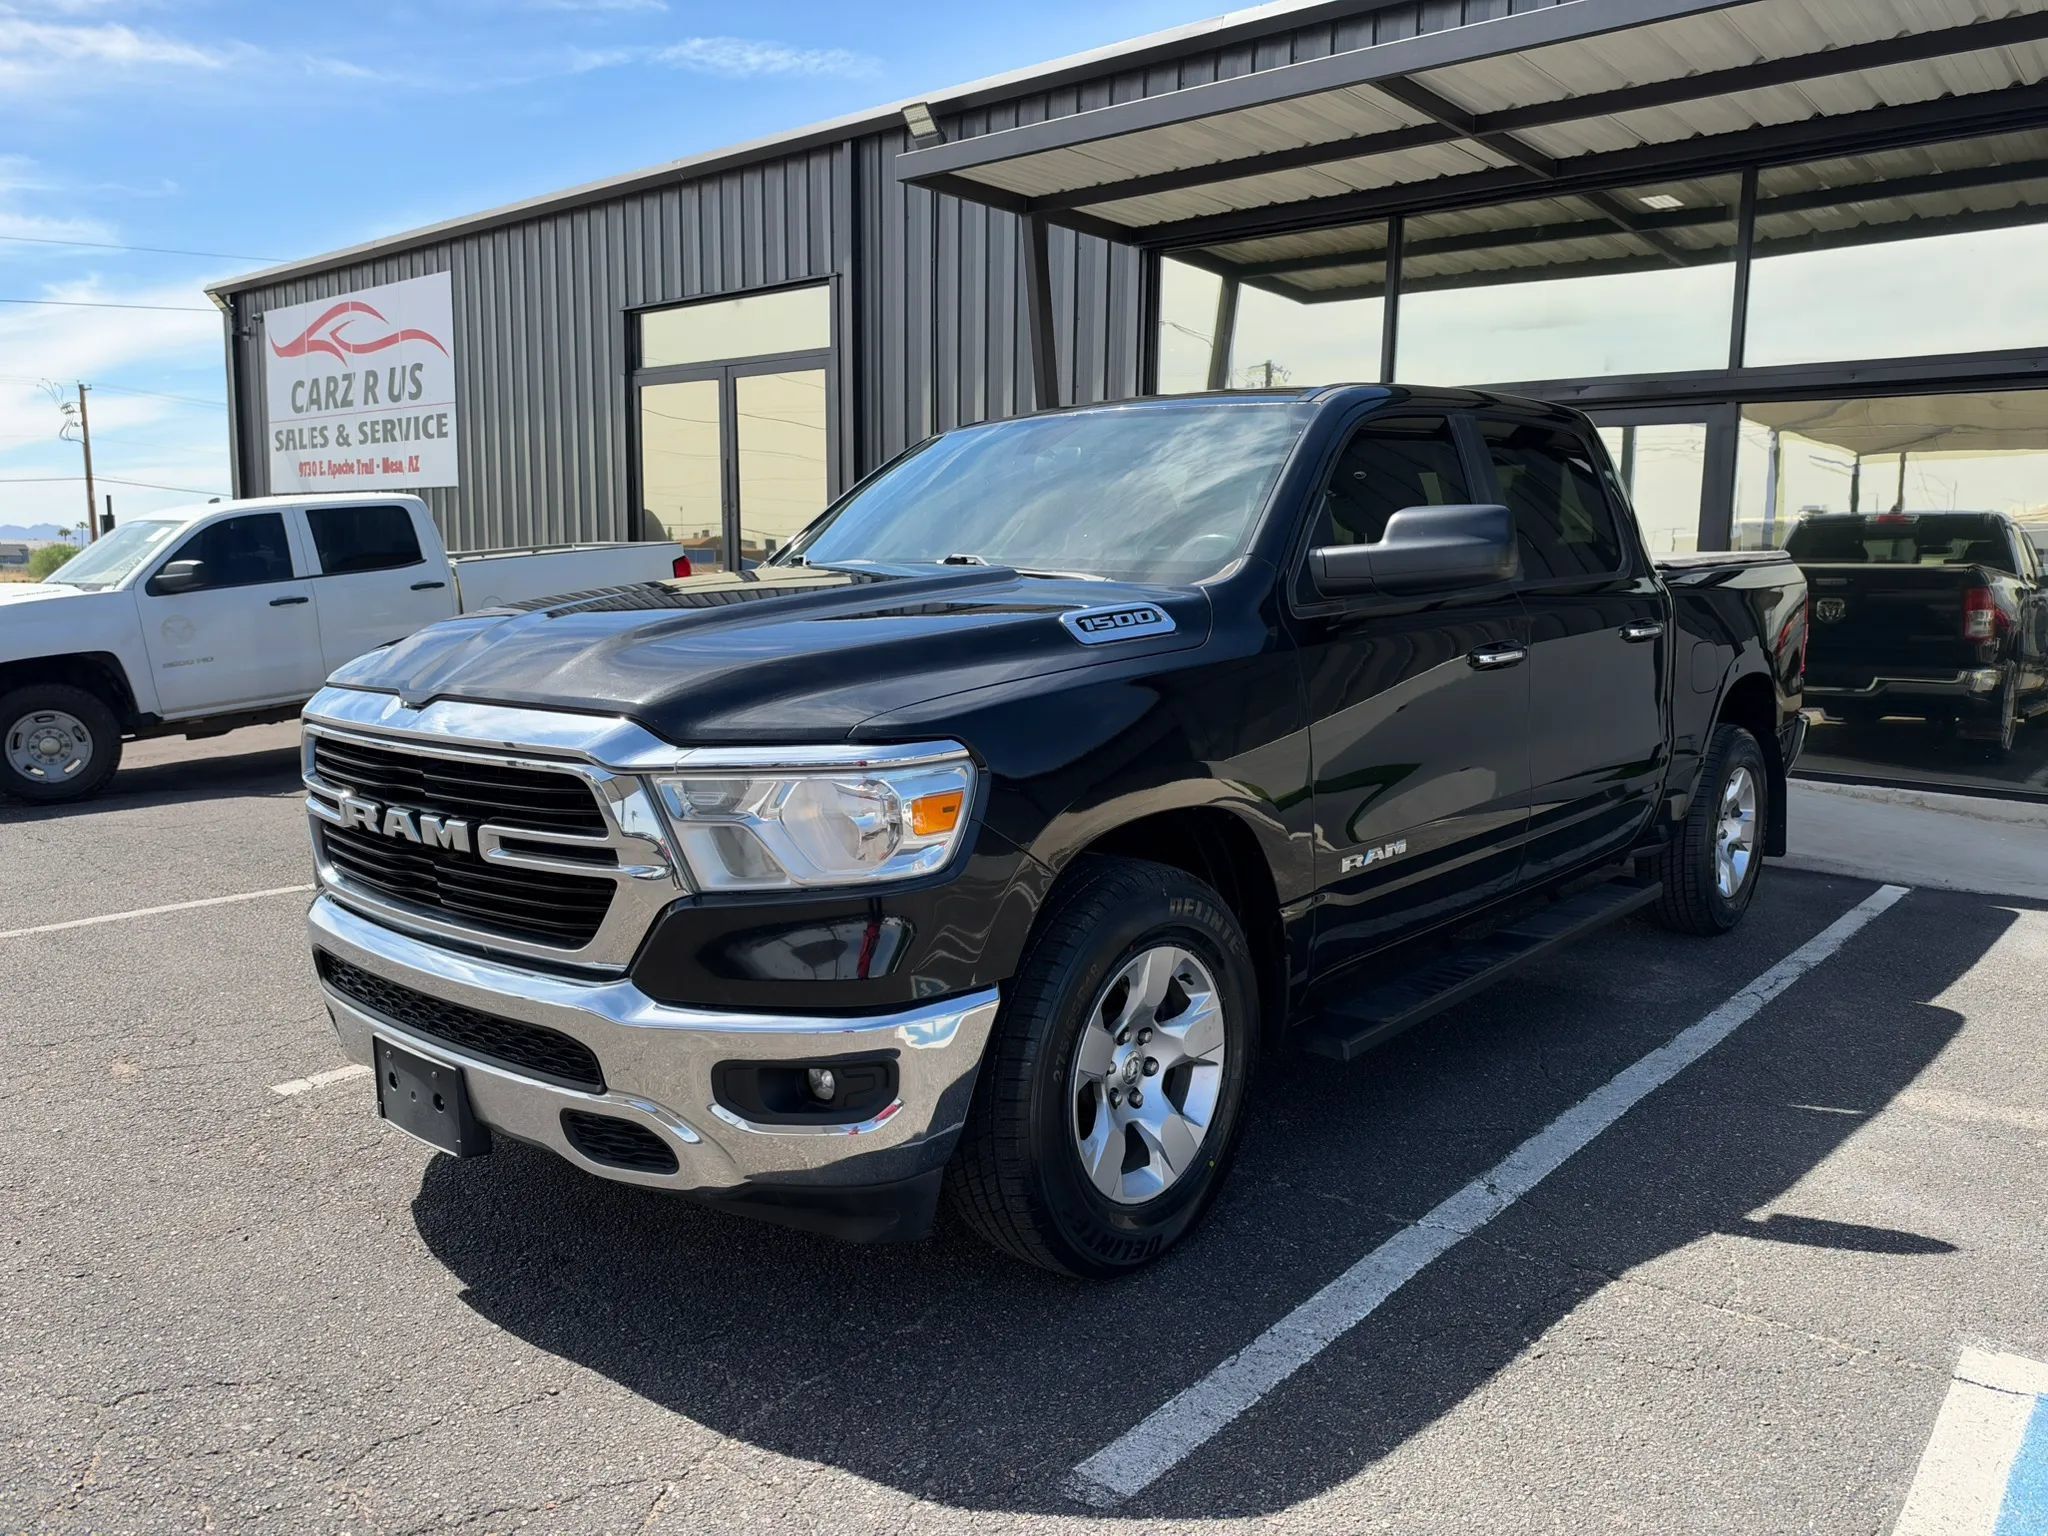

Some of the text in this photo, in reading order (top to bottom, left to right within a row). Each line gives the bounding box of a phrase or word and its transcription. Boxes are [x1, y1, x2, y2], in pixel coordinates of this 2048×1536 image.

[291, 362, 424, 414] CARZ R US
[274, 413, 449, 452] SALES & SERVICE
[327, 458, 355, 479] Apache
[356, 457, 375, 475] Trail
[408, 455, 420, 473] AZ
[1079, 610, 1157, 632] 1500
[344, 796, 471, 853] RAM
[1339, 838, 1407, 873] RAM
[1169, 896, 1241, 955] DELINTE
